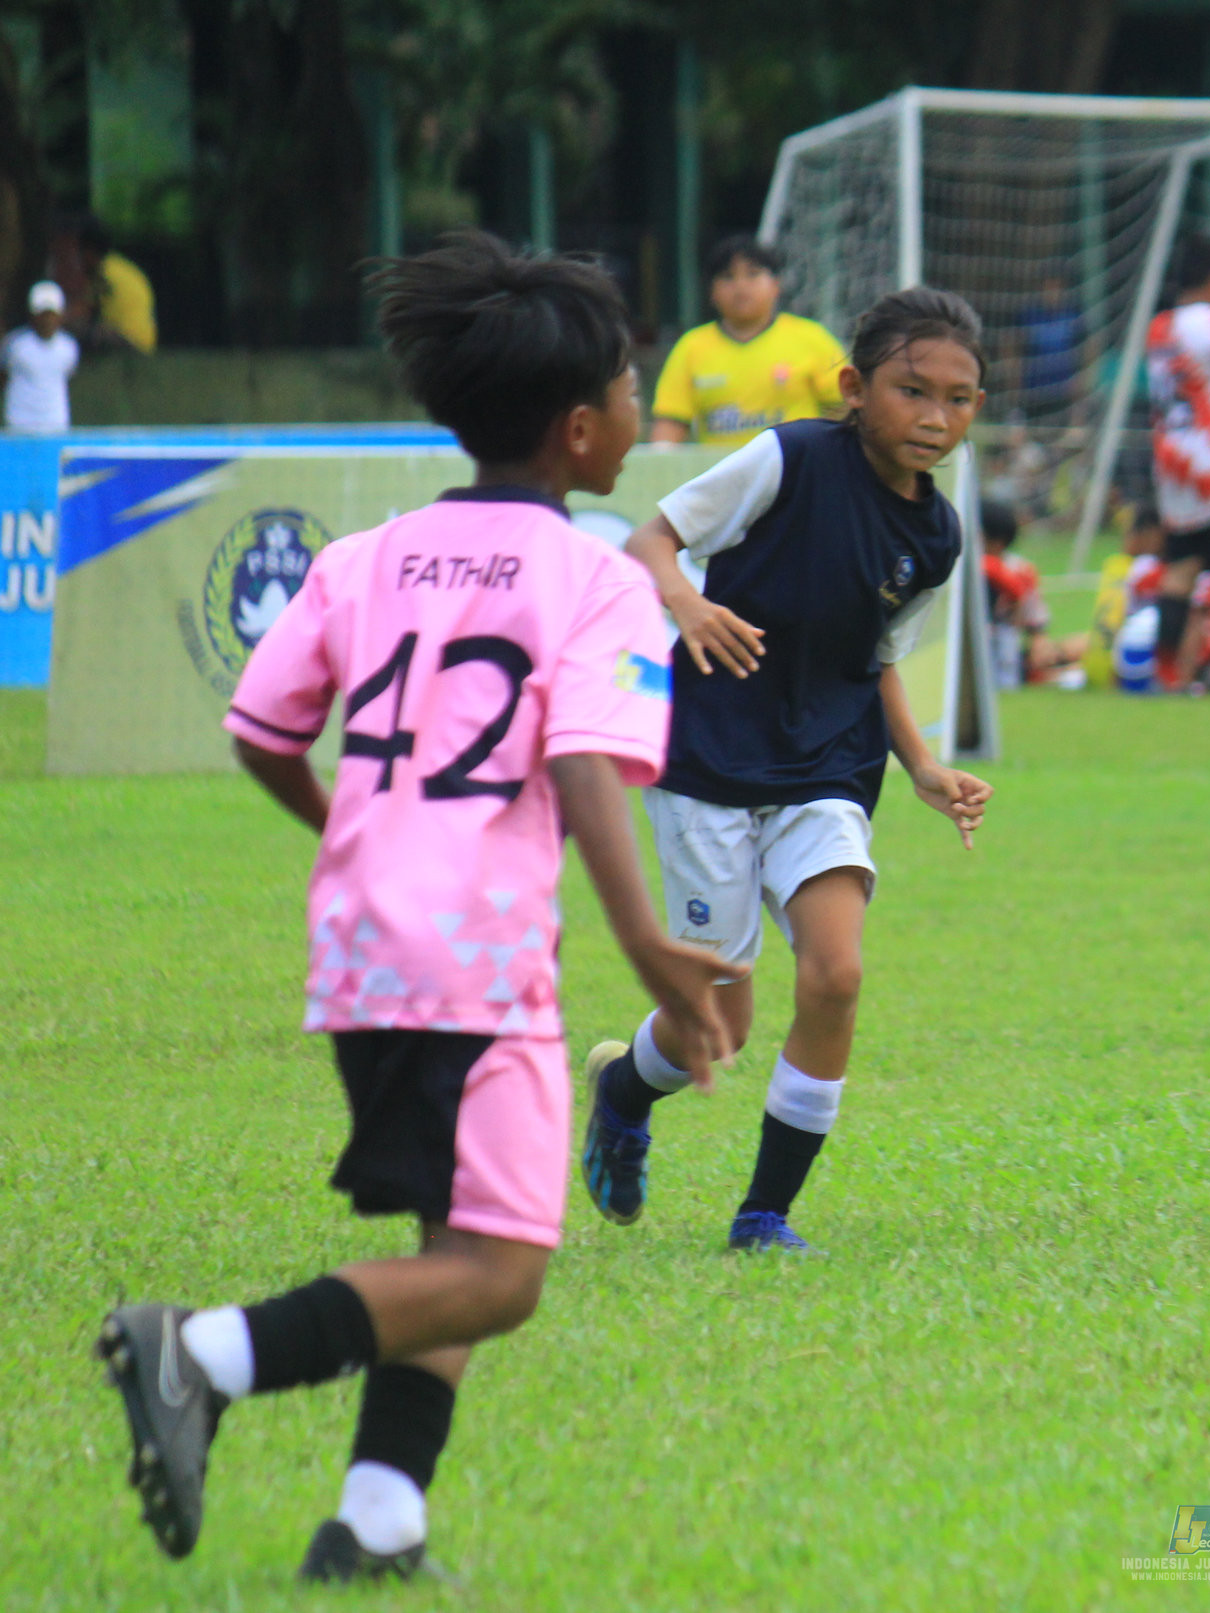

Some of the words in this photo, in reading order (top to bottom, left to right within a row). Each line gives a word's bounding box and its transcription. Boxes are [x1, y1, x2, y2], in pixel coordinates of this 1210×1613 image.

[247, 549, 306, 577] PSSI
[397, 553, 522, 591] FATHIR
[341, 630, 535, 803] 42
